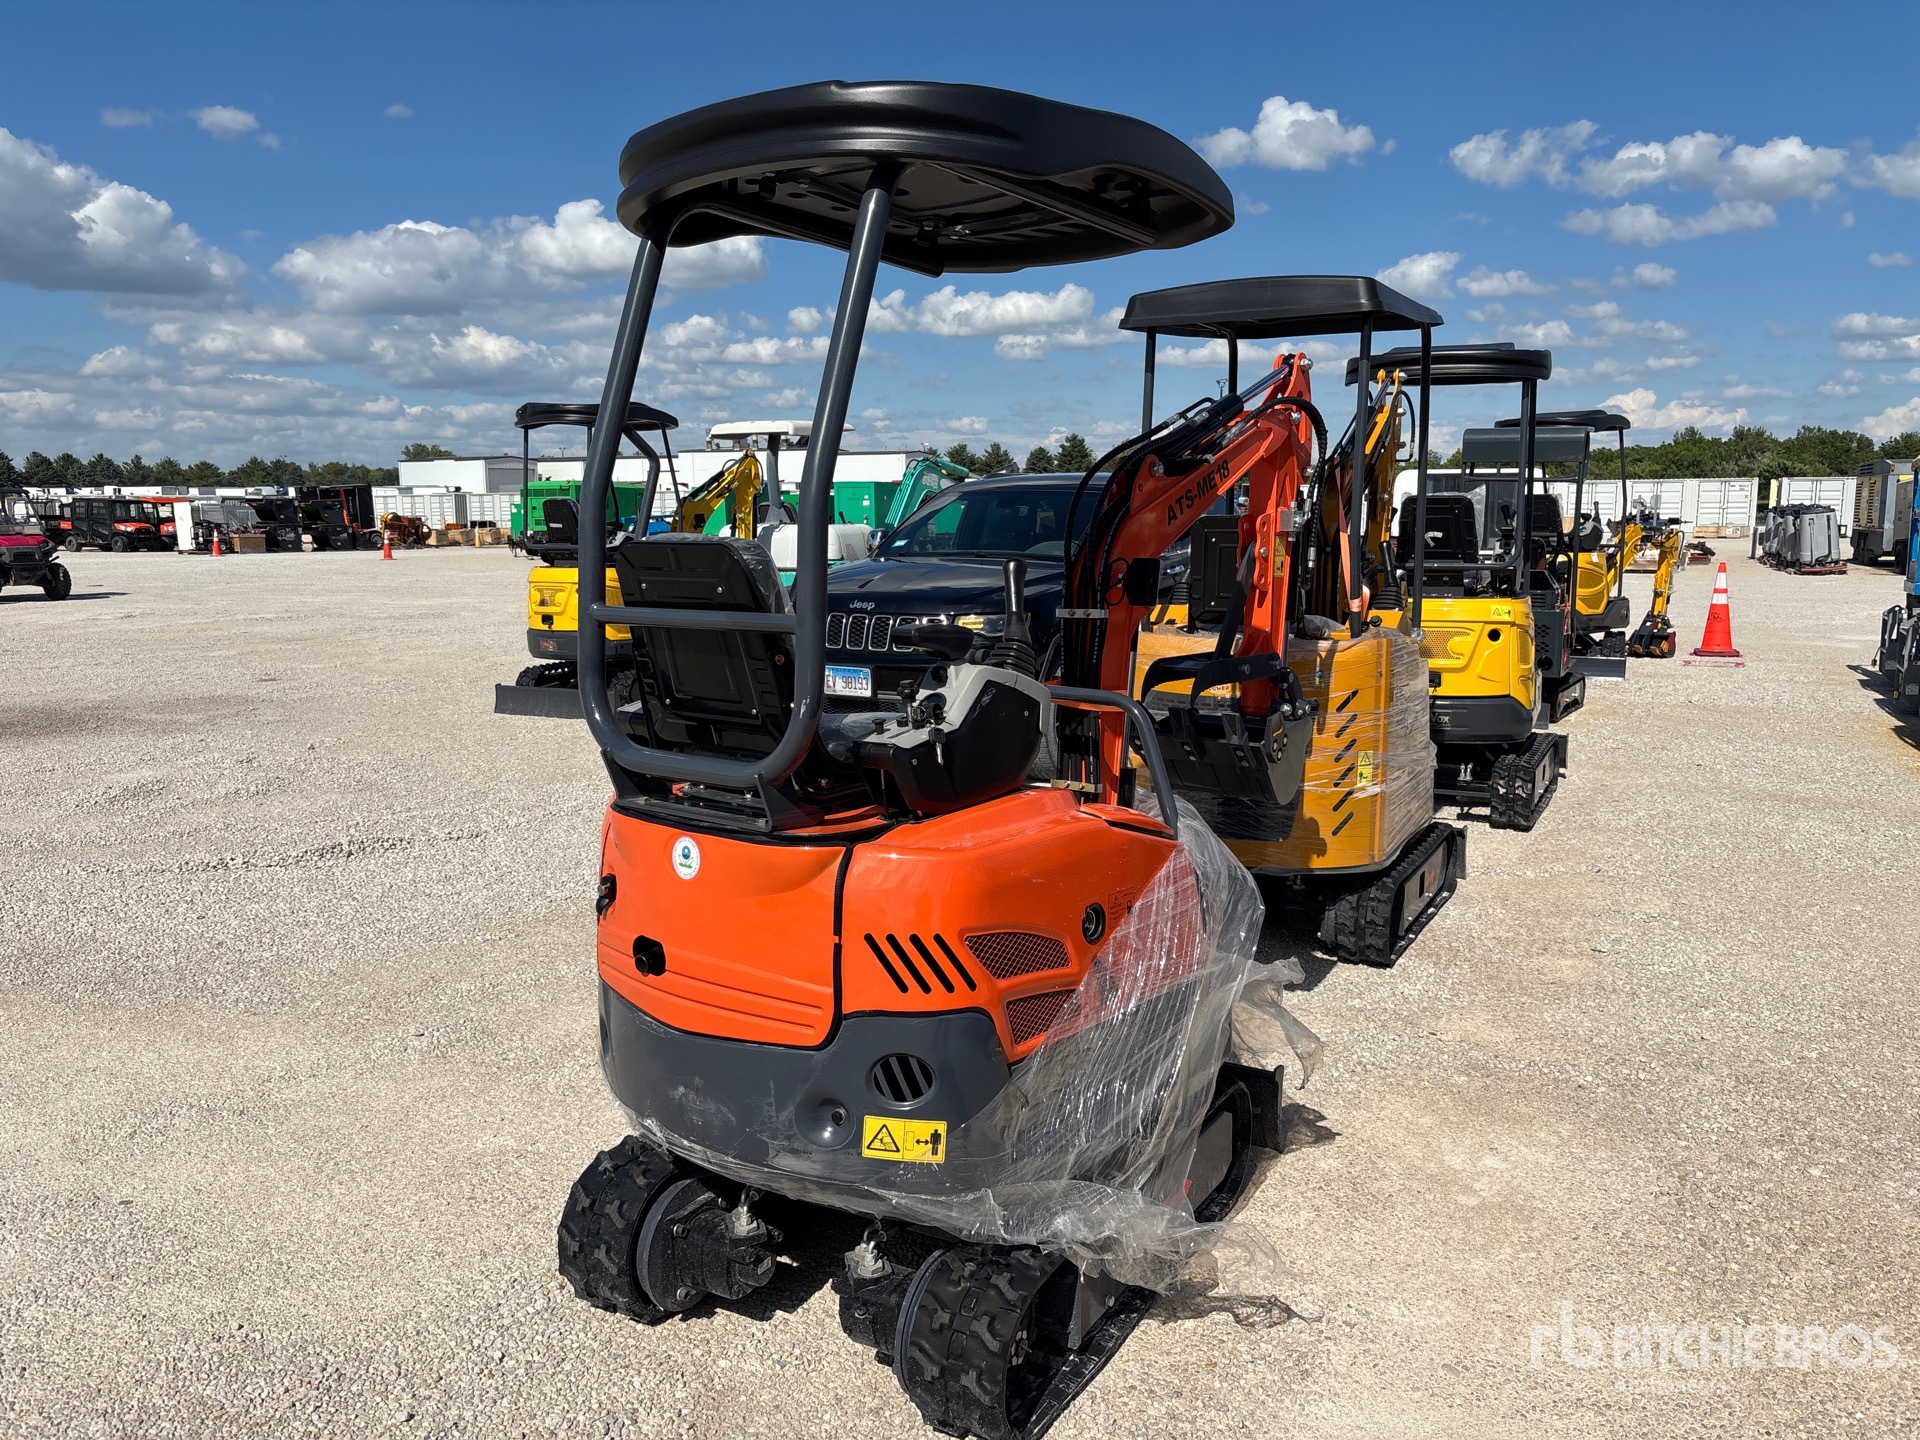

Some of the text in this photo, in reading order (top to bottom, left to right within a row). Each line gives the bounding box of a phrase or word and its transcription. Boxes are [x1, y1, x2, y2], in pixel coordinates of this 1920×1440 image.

[1167, 459, 1231, 527] ATS-ME18
[849, 599, 876, 611] Jeep
[841, 675, 869, 691] 98193
